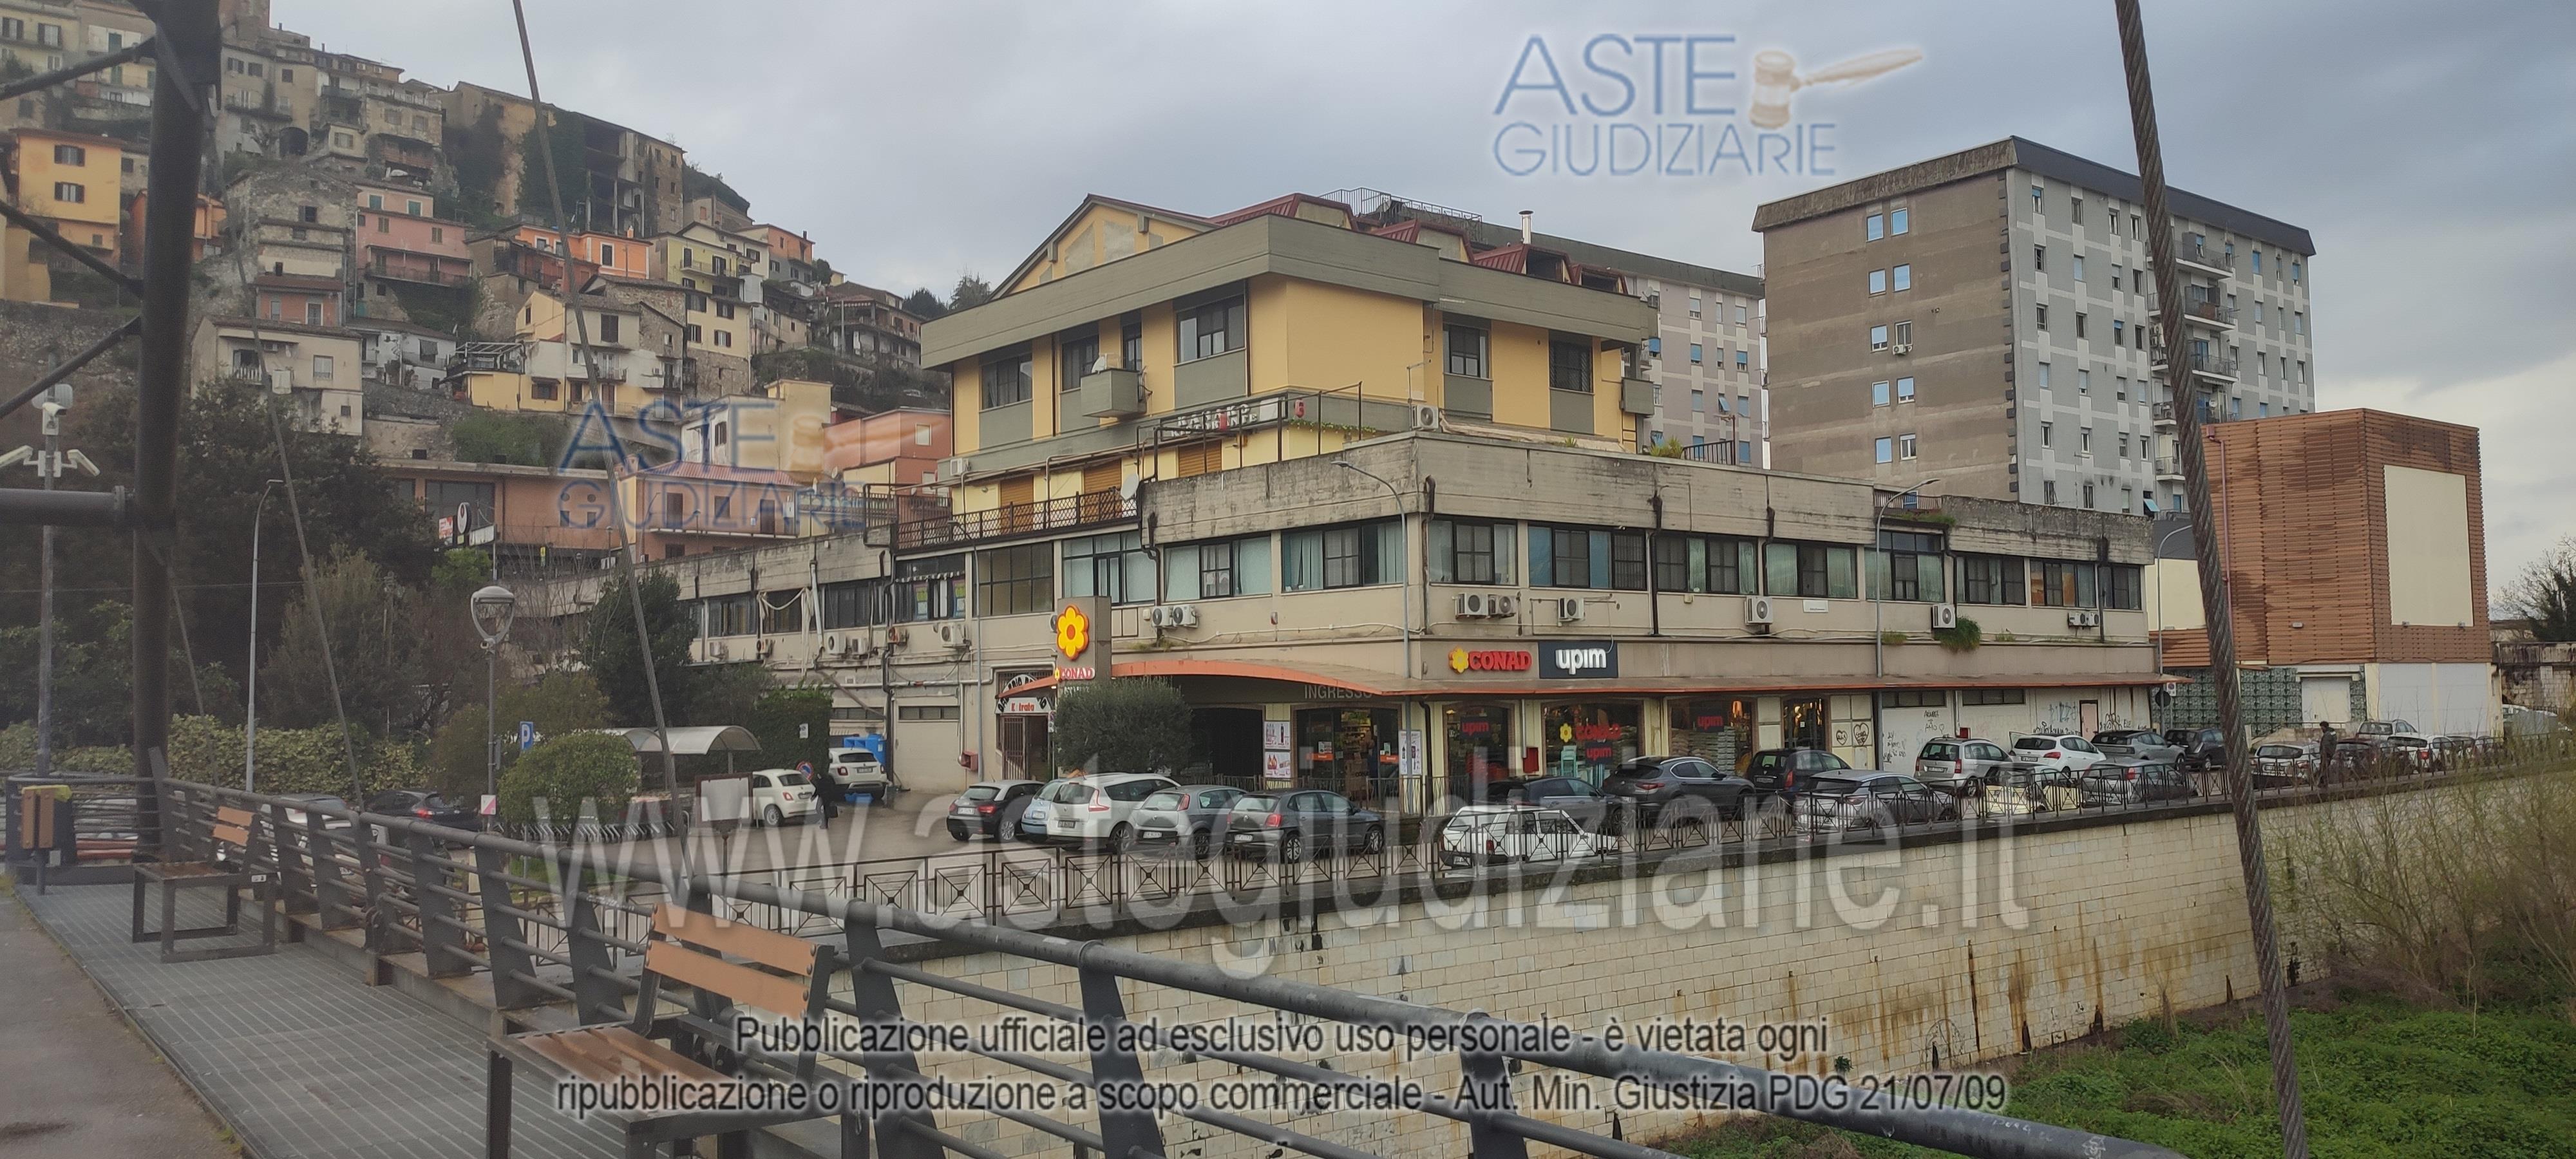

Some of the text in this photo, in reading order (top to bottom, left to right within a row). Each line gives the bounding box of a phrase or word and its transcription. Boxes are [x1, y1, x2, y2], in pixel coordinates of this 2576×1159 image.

[1468, 650, 1532, 671] CONAD
[1555, 648, 1607, 675] upim
[1061, 667, 1095, 681] CONAD
[1462, 721, 1490, 736] upim
[1697, 715, 1723, 730] upim
[522, 724, 531, 750] P
[1586, 748, 1613, 761] upim
